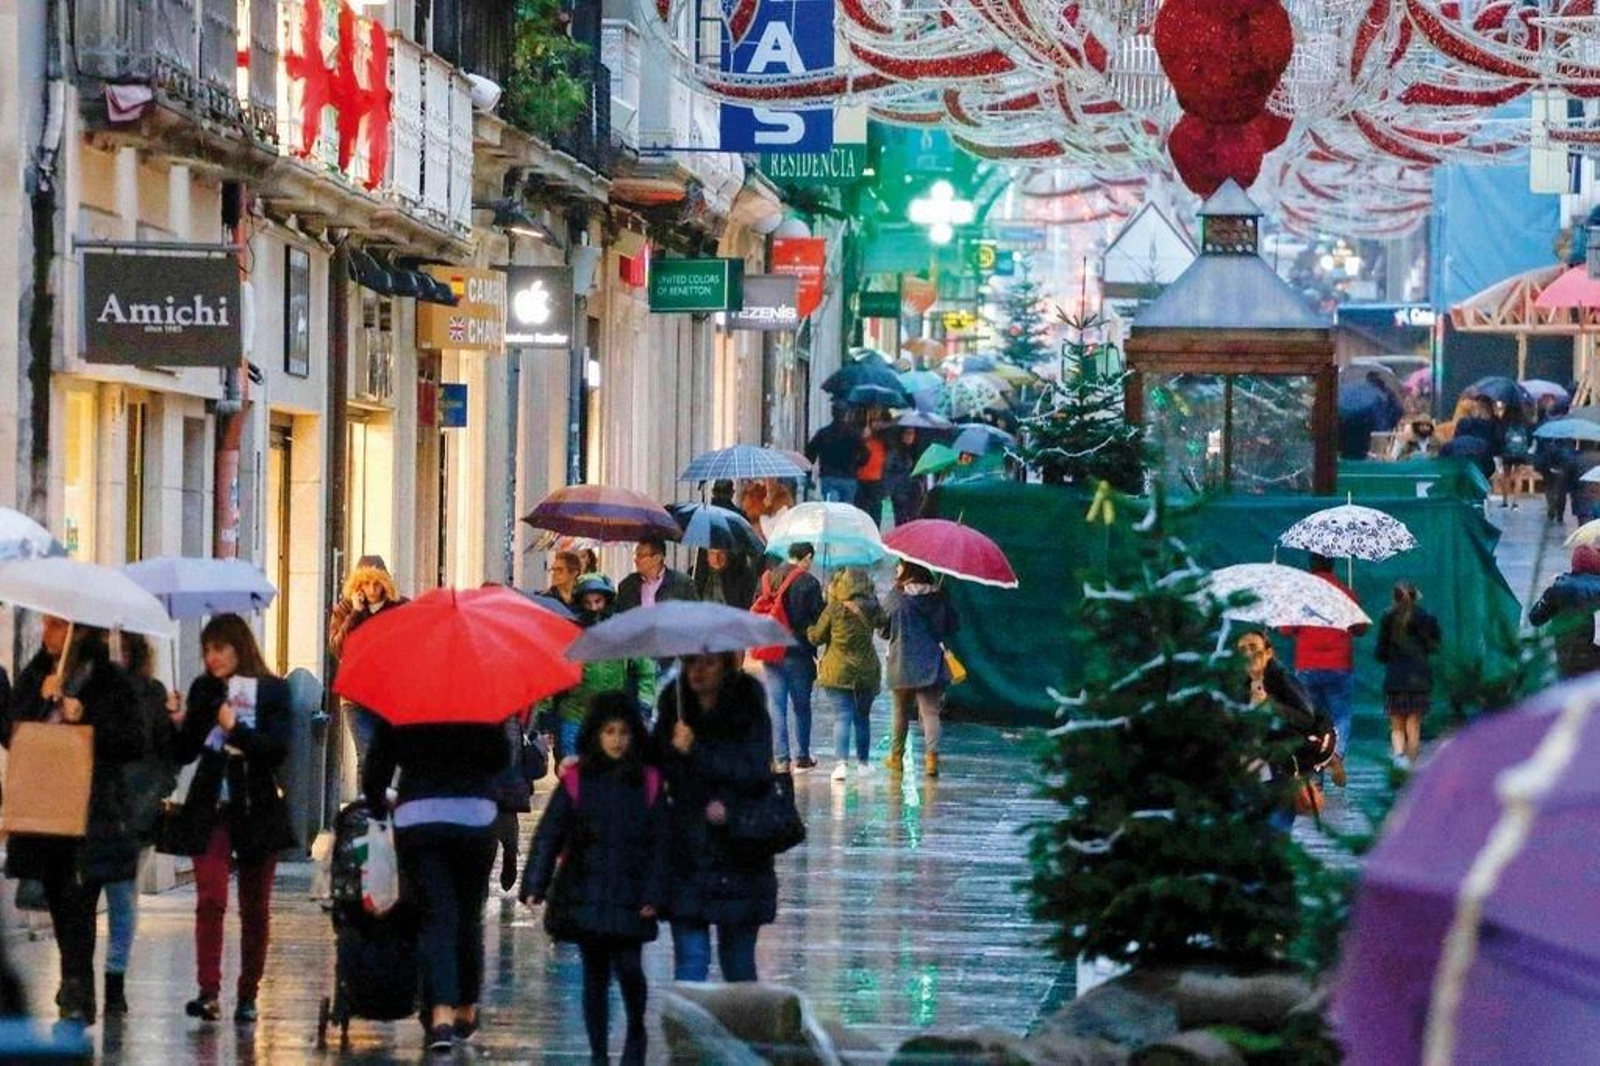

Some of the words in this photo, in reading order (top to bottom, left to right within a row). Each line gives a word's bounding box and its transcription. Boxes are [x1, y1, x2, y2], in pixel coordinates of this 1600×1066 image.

[771, 147, 855, 177] RESIDENCIA
[657, 274, 687, 285] UNITED
[689, 273, 720, 285] COLORS
[669, 286, 712, 297] BENETTON
[97, 293, 229, 326] Amichi
